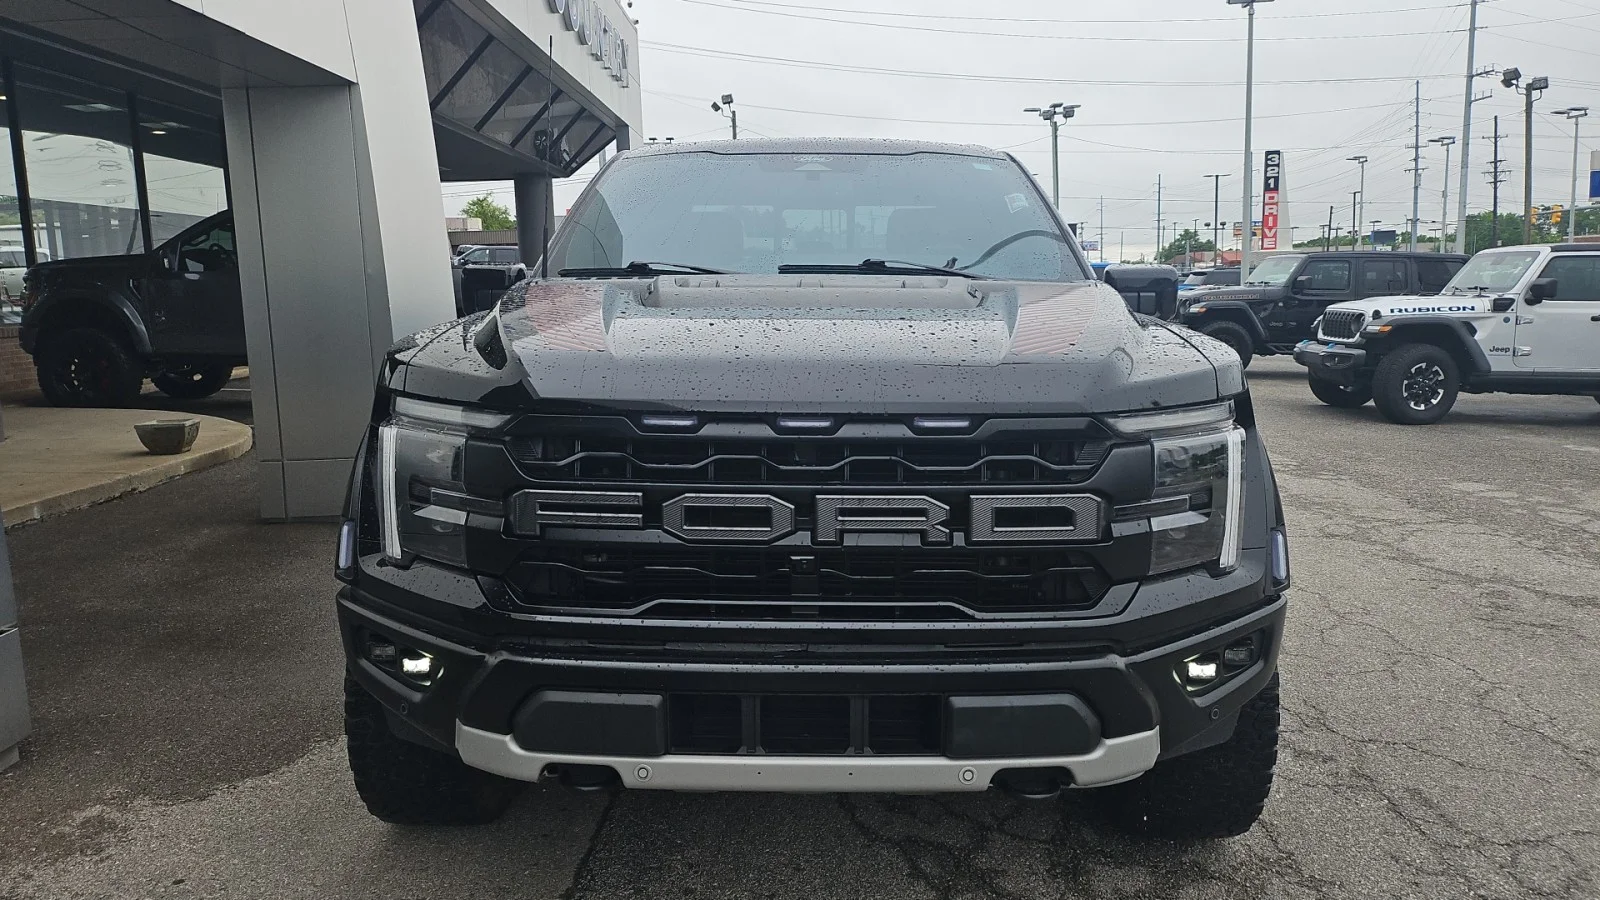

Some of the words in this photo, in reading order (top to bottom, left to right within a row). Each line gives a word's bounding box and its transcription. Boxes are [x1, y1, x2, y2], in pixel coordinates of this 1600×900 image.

[548, 0, 629, 88] OUNTRY
[1263, 193, 1278, 249] DRIVE
[1390, 305, 1476, 314] RUBICON
[1489, 345, 1511, 354] Jeep
[508, 489, 1104, 546] FORD
